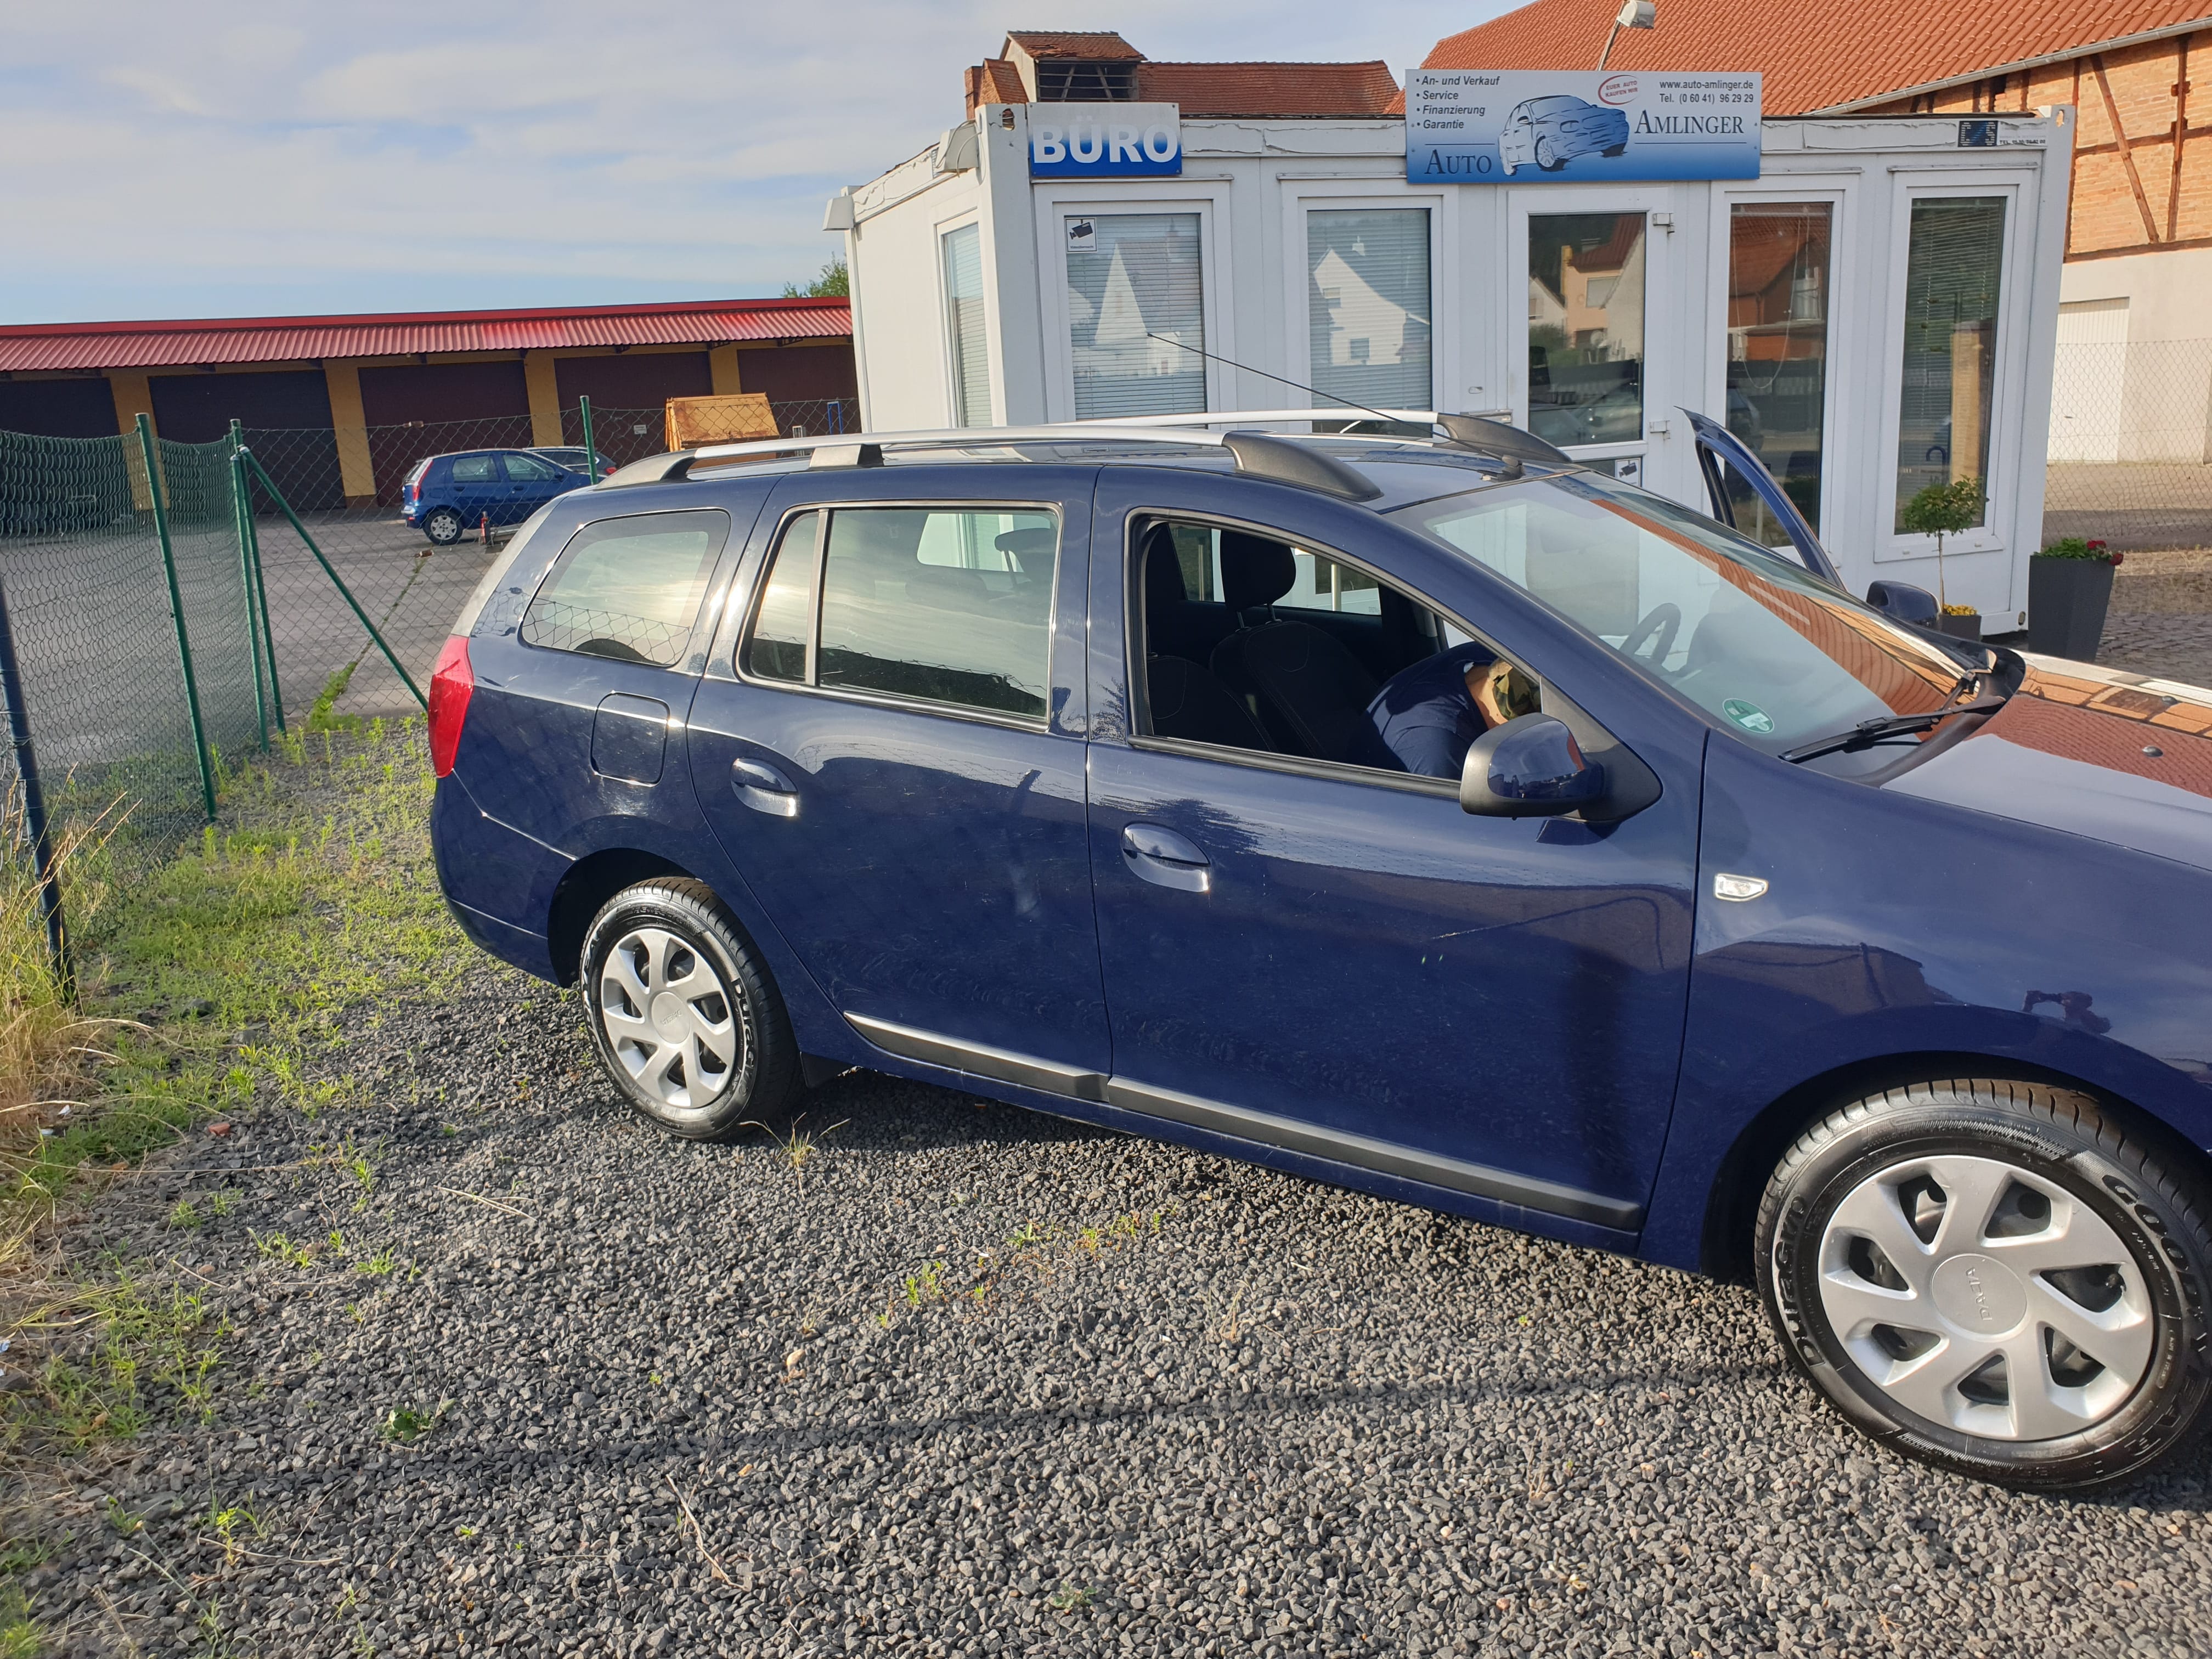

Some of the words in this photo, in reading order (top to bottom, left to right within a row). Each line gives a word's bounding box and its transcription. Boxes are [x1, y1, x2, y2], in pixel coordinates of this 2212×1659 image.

[1421, 76, 1438, 85] An-
[1442, 76, 1460, 85] und
[1463, 76, 1500, 85] Verkauf
[1659, 80, 1753, 91] www.auto-amlinger.de
[1423, 91, 1459, 100] Service
[1659, 93, 1674, 103] Tel.
[1690, 94, 1700, 103] 60
[1702, 93, 1715, 105] 41)
[1719, 94, 1729, 103] 96
[1731, 94, 1741, 103] 29
[1743, 94, 1754, 103] 29
[1423, 105, 1486, 117] Finanzierung
[1423, 120, 1464, 129] Garantie
[1634, 109, 1744, 134] AMLINGER
[1032, 115, 1178, 163] BÜRO
[1424, 149, 1492, 174] AUTO
[1966, 1266, 1993, 1321] DACIA
